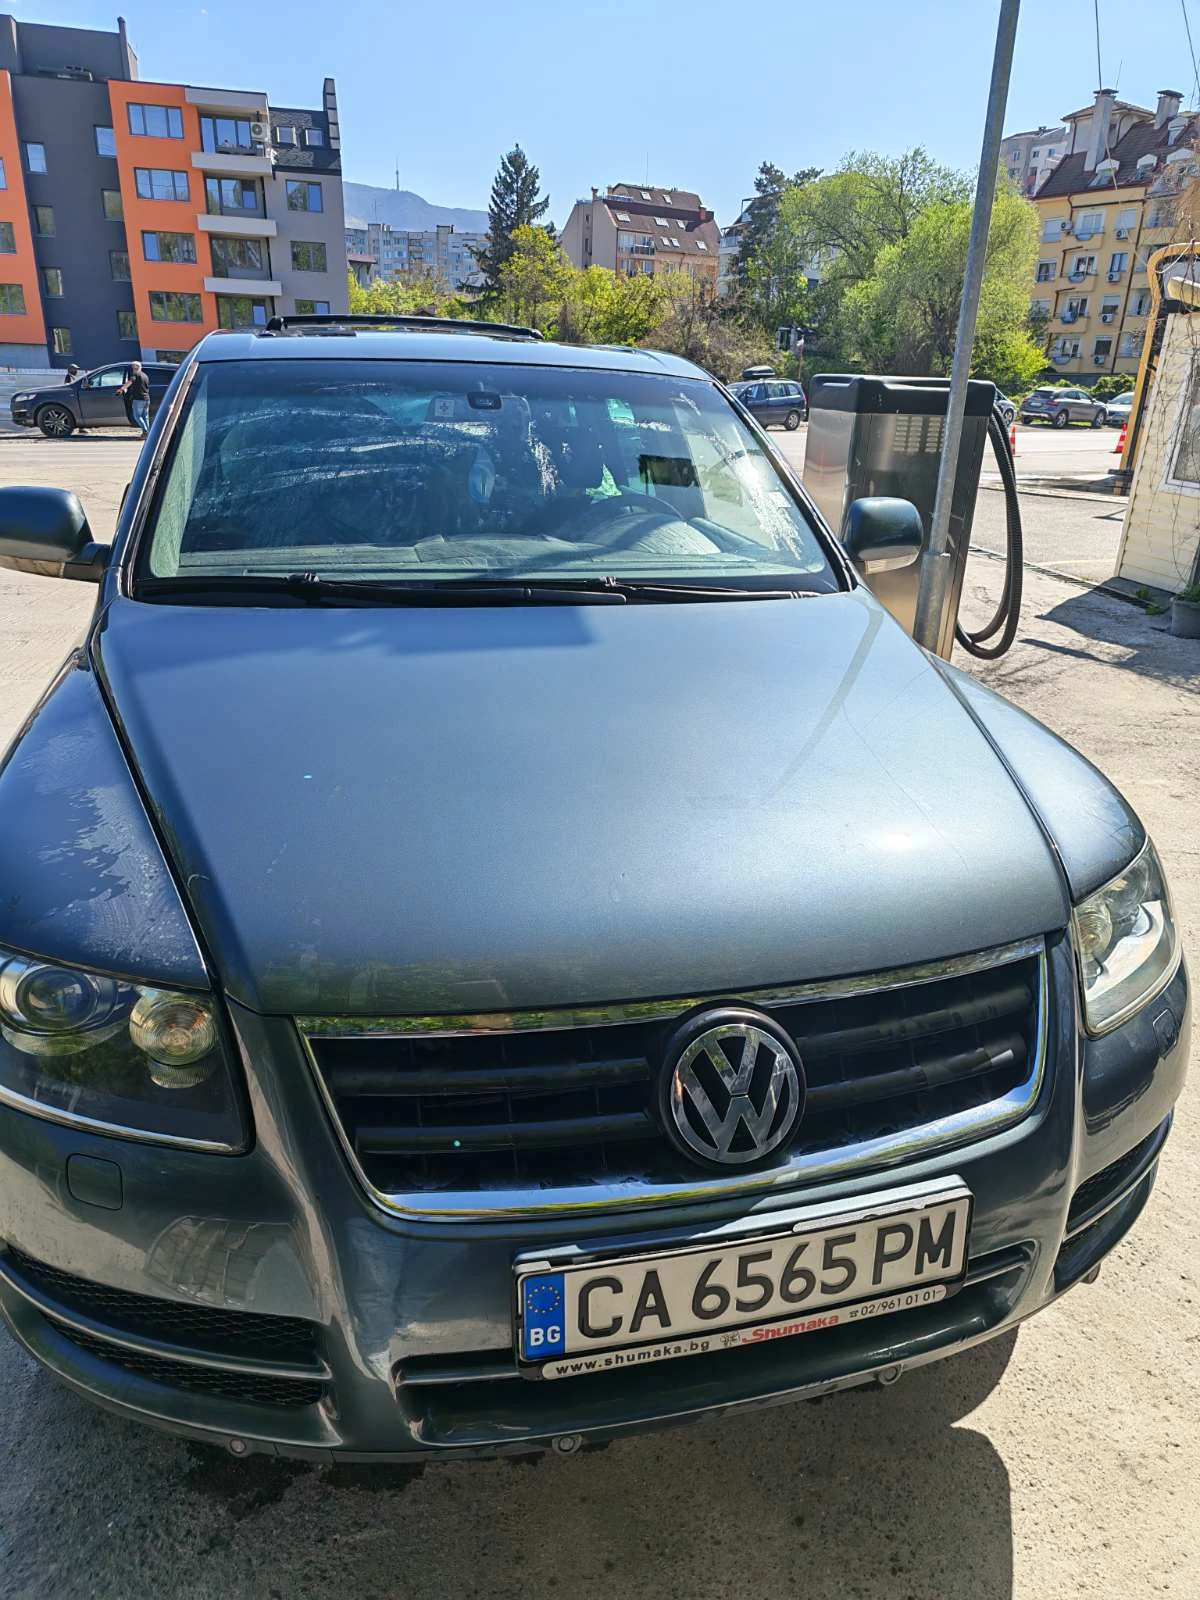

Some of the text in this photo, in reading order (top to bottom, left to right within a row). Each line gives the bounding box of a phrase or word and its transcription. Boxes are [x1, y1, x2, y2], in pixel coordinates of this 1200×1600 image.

[671, 1024, 799, 1163] VW
[577, 1211, 958, 1338] CA 6565 PM
[529, 1325, 561, 1346] BG
[555, 1340, 710, 1375] www.shumaka.bg
[742, 1315, 840, 1344] Shumaka
